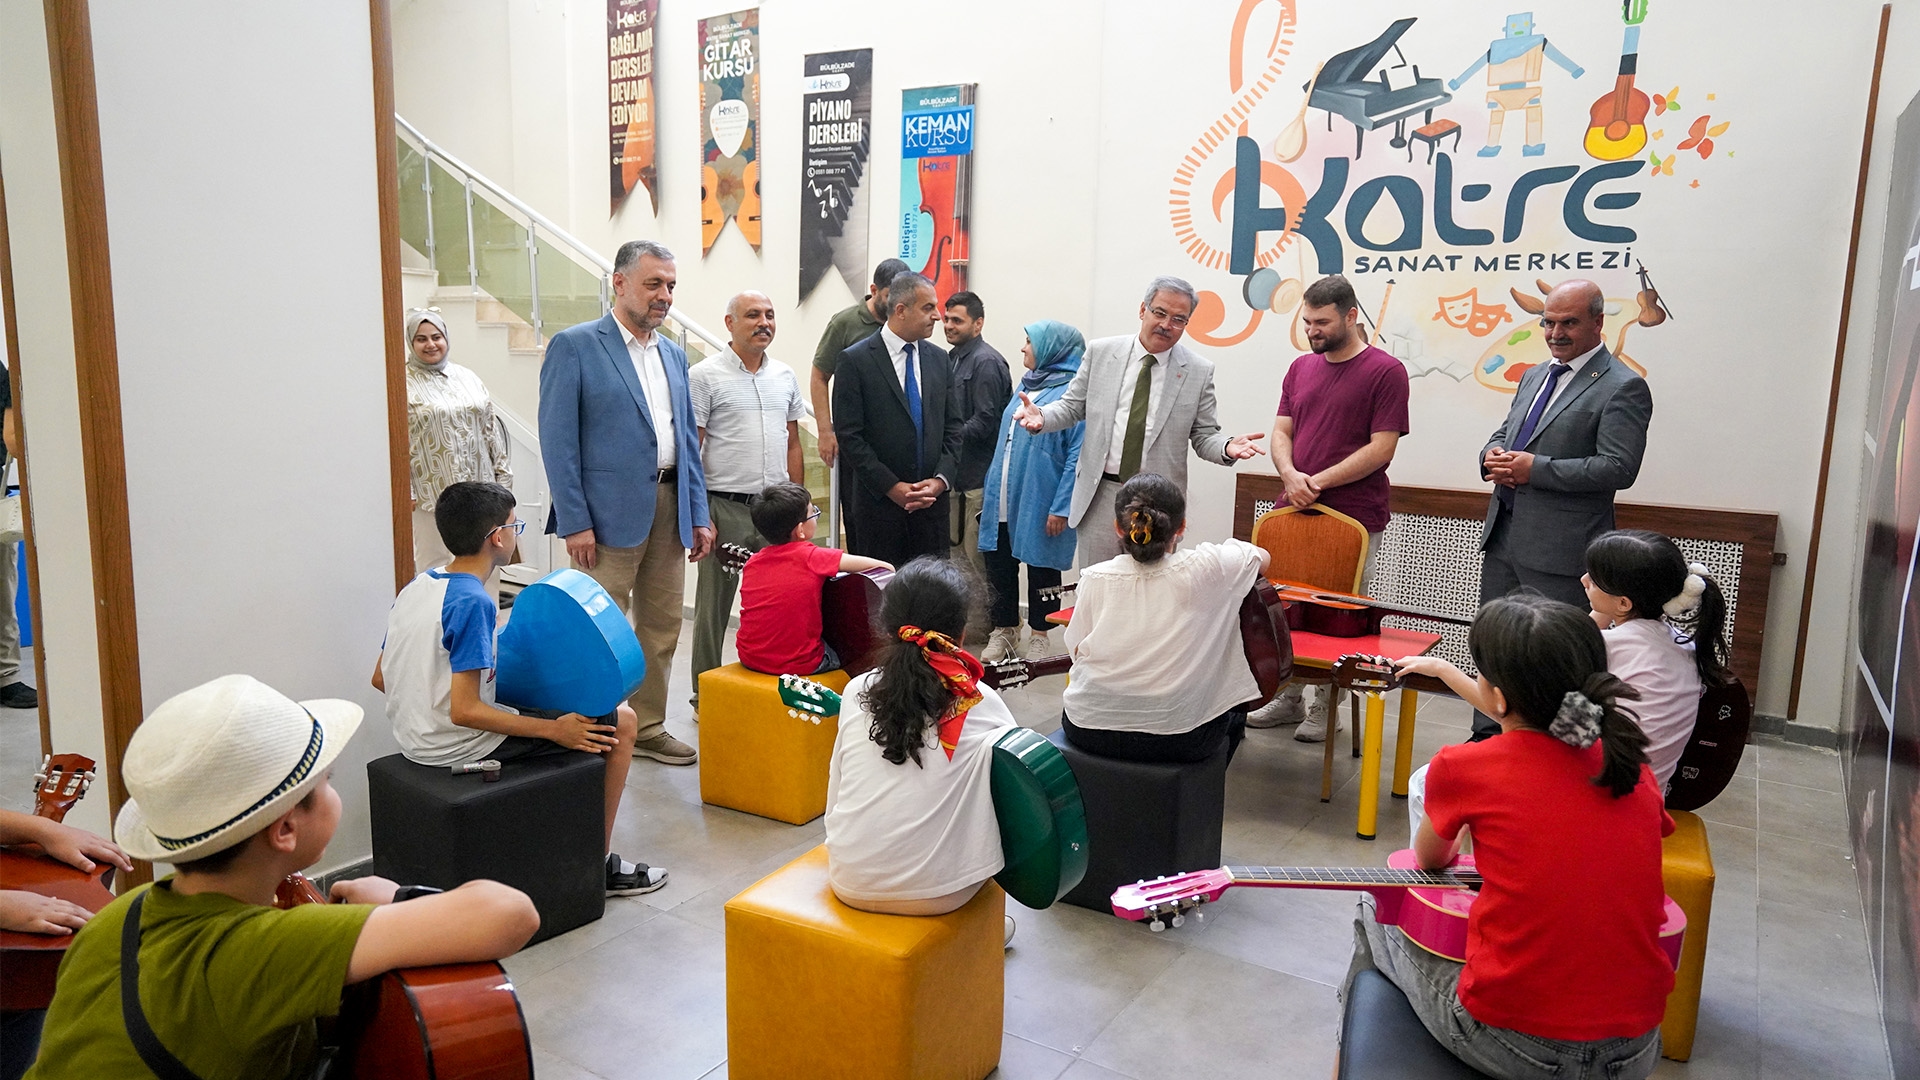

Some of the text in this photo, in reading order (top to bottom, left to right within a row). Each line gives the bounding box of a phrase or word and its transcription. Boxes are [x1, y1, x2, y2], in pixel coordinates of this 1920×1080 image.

[704, 39, 753, 63] GİTAR
[703, 56, 754, 81] KURSU
[611, 78, 648, 103] DEVAM
[611, 101, 648, 126] EDİYOR
[809, 98, 852, 122] PİYANO
[808, 117, 863, 145] DERSLERİ
[905, 112, 970, 135] KEMAN
[905, 126, 969, 148] KURSU
[900, 213, 913, 258] İletişim
[1354, 247, 1631, 274] SANAT MERKEZİ
